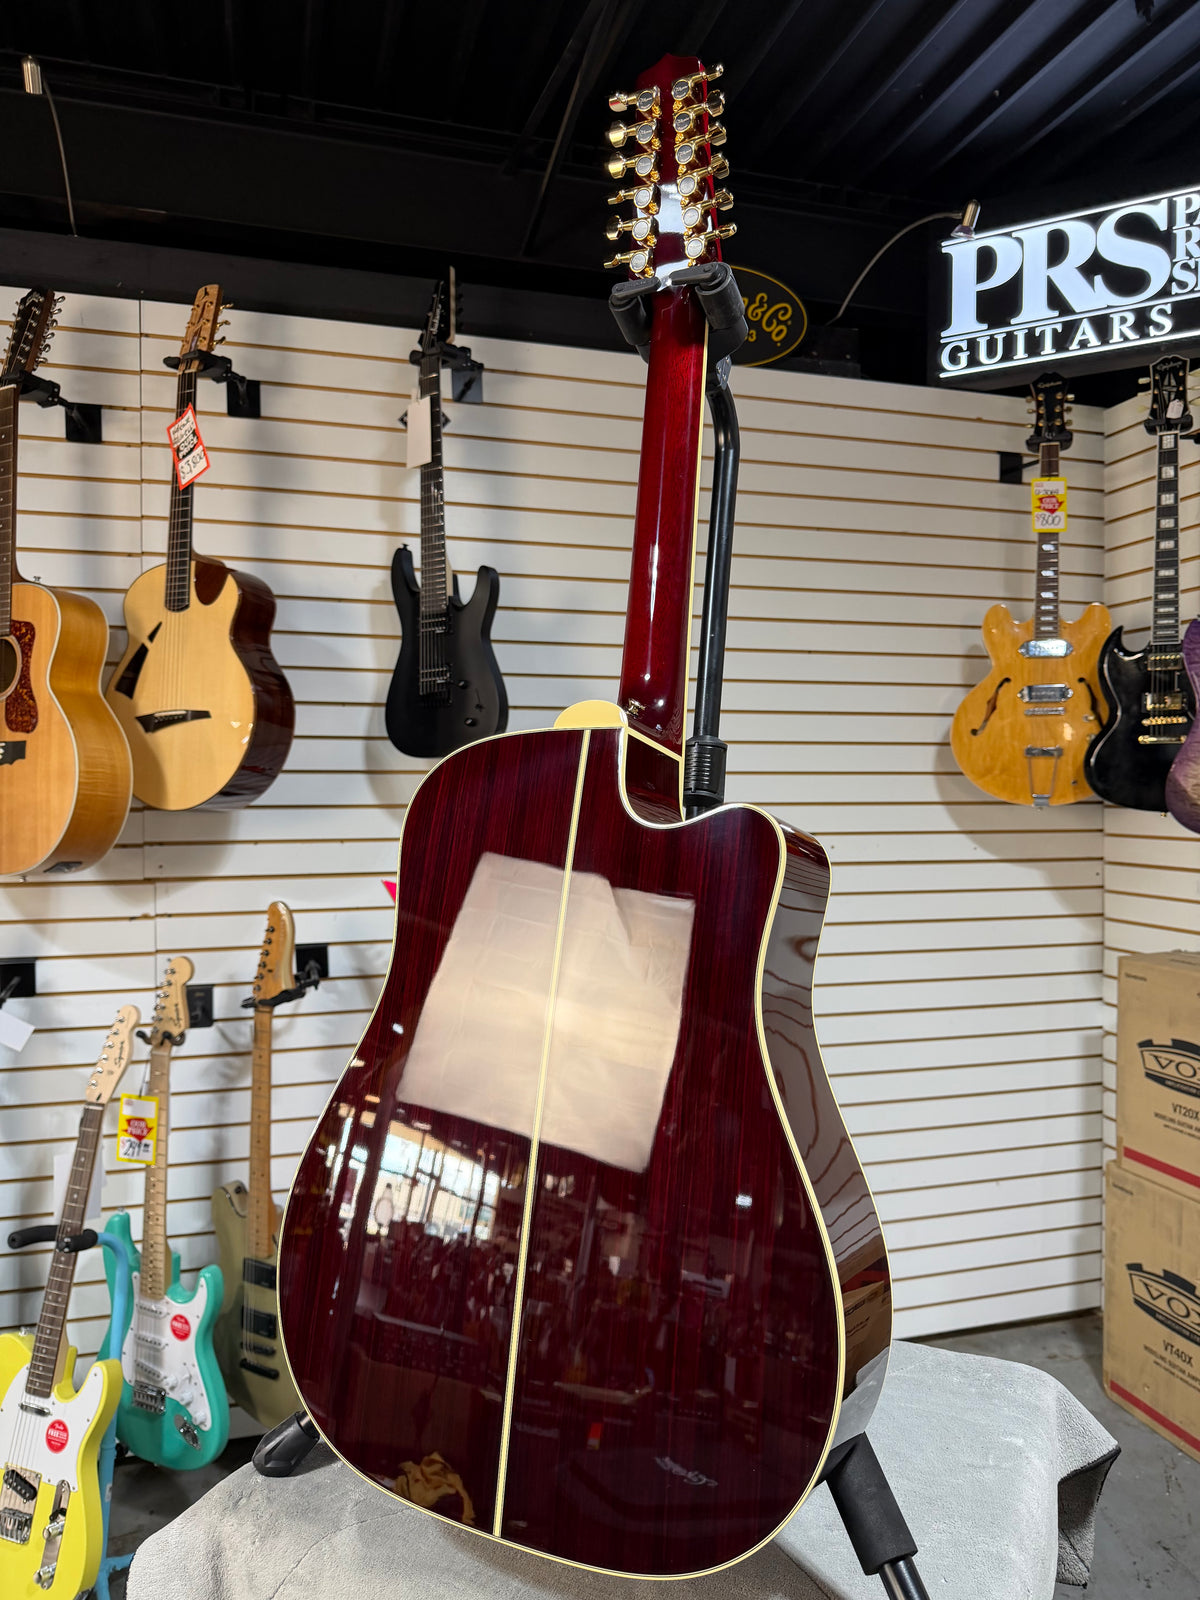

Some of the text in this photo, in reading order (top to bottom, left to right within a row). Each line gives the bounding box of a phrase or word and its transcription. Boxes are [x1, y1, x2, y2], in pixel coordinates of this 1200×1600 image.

[941, 198, 1171, 337] PRS
[940, 304, 1173, 371] GUITARS
[1148, 1053, 1200, 1081] VO
